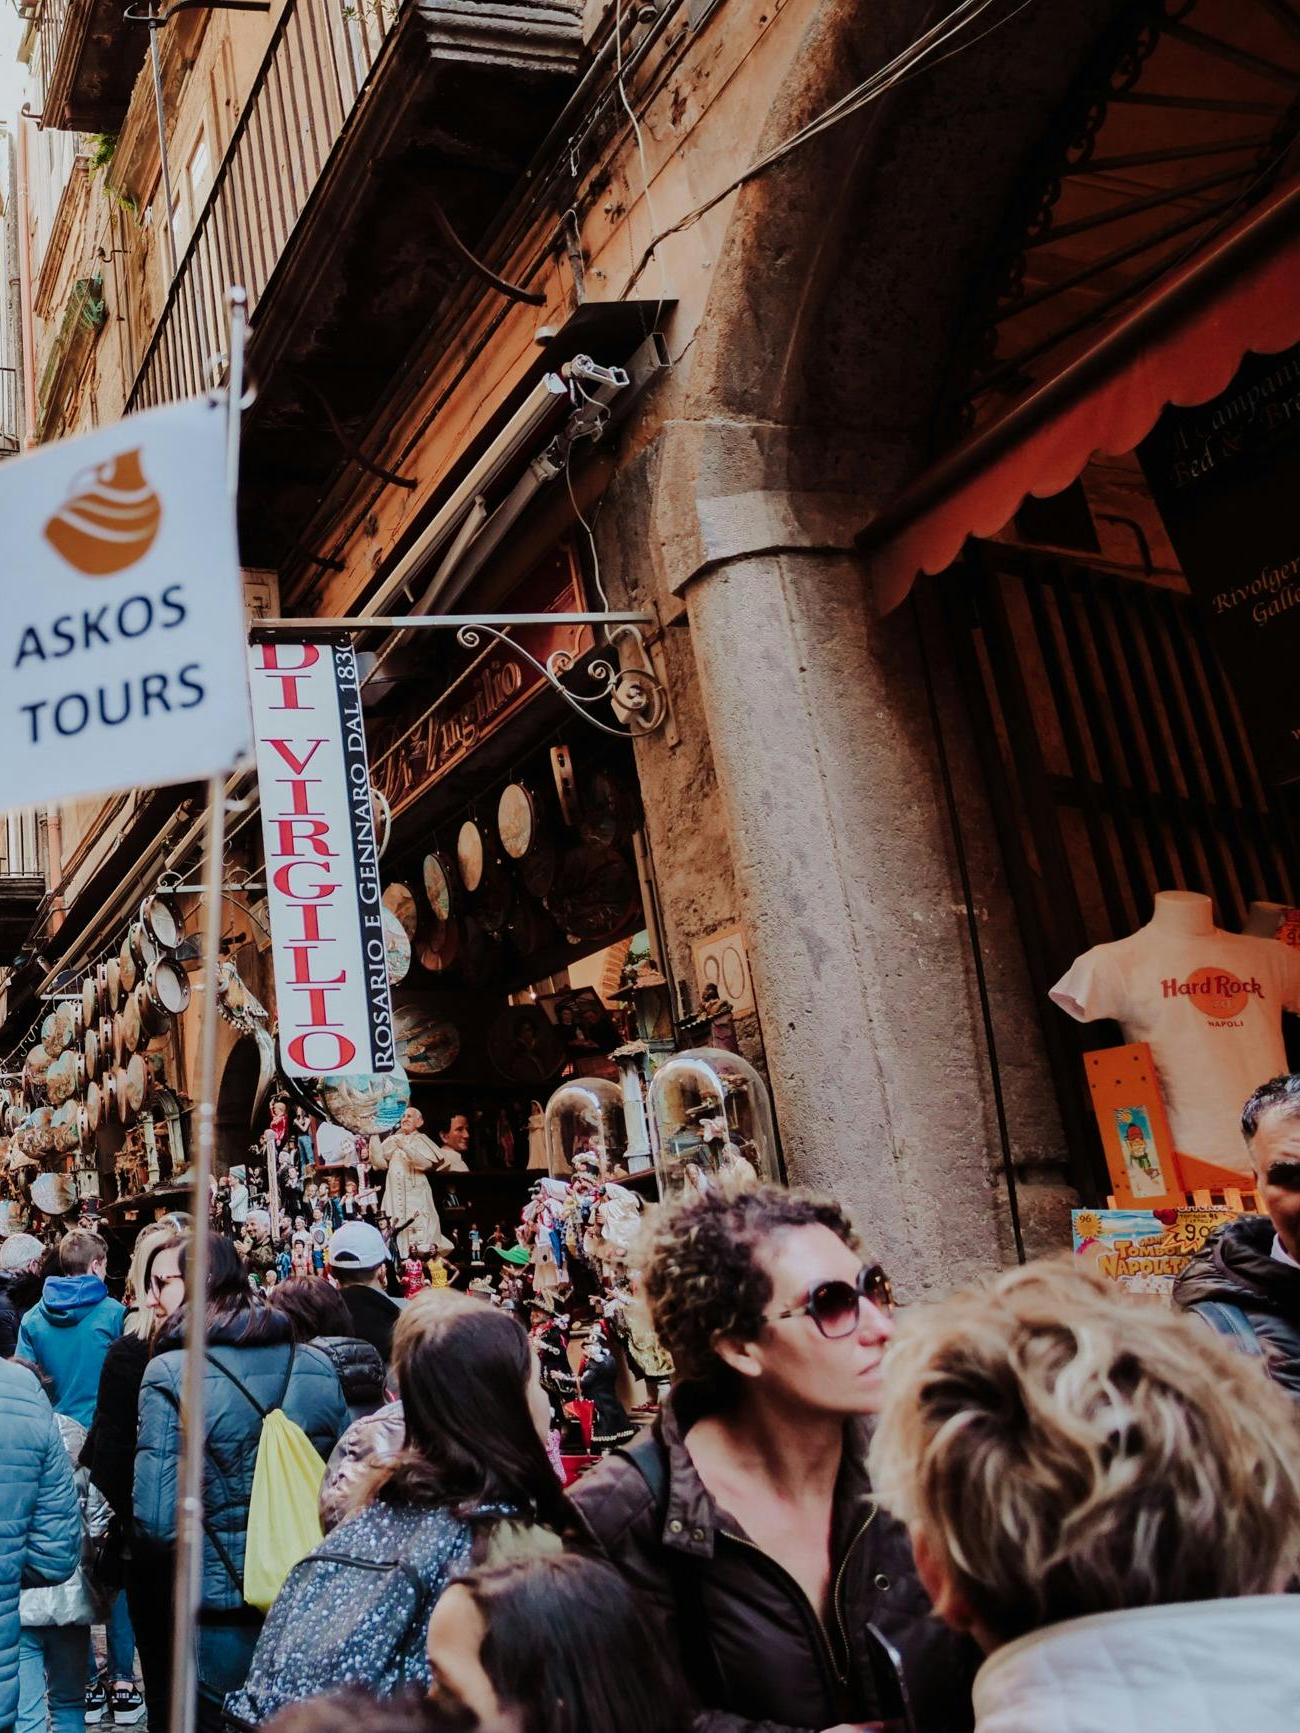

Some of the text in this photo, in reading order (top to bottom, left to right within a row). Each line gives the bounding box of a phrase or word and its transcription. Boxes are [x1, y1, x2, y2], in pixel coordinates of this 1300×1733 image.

[14, 583, 187, 668] ASKOS
[19, 662, 206, 743] TOURS
[345, 702, 364, 753] DAL
[254, 643, 357, 1072] DI VIRGILIO
[351, 763, 380, 905] GENNARO
[364, 914, 381, 928] E
[367, 938, 395, 1068] ROSARIO
[1161, 975, 1265, 999] Hard Rock
[1207, 1020, 1244, 1028] NAPOLI
[1079, 1215, 1092, 1224] 96
